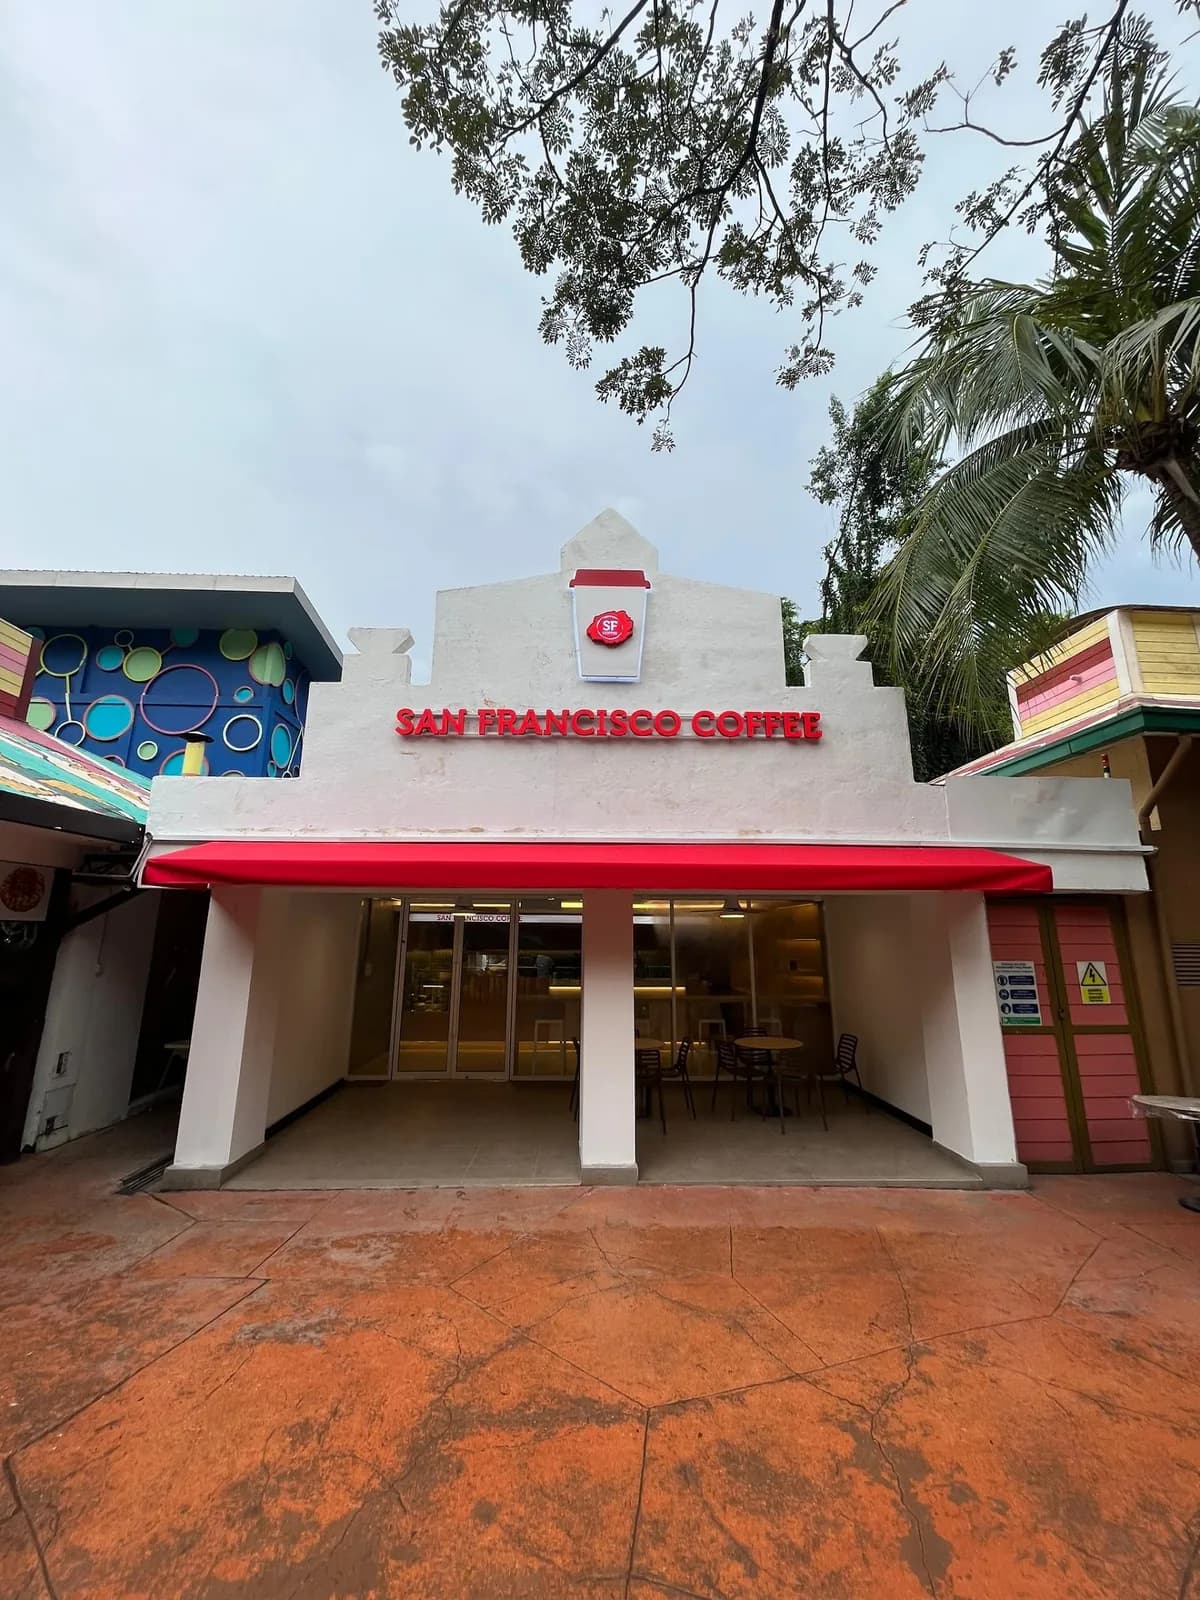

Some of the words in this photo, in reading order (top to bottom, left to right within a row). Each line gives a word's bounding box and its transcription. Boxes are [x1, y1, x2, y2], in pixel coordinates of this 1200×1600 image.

[602, 620, 618, 631] SF
[395, 708, 467, 736] SAN
[477, 709, 682, 737] FRANCISCO
[691, 710, 823, 739] COFFEE
